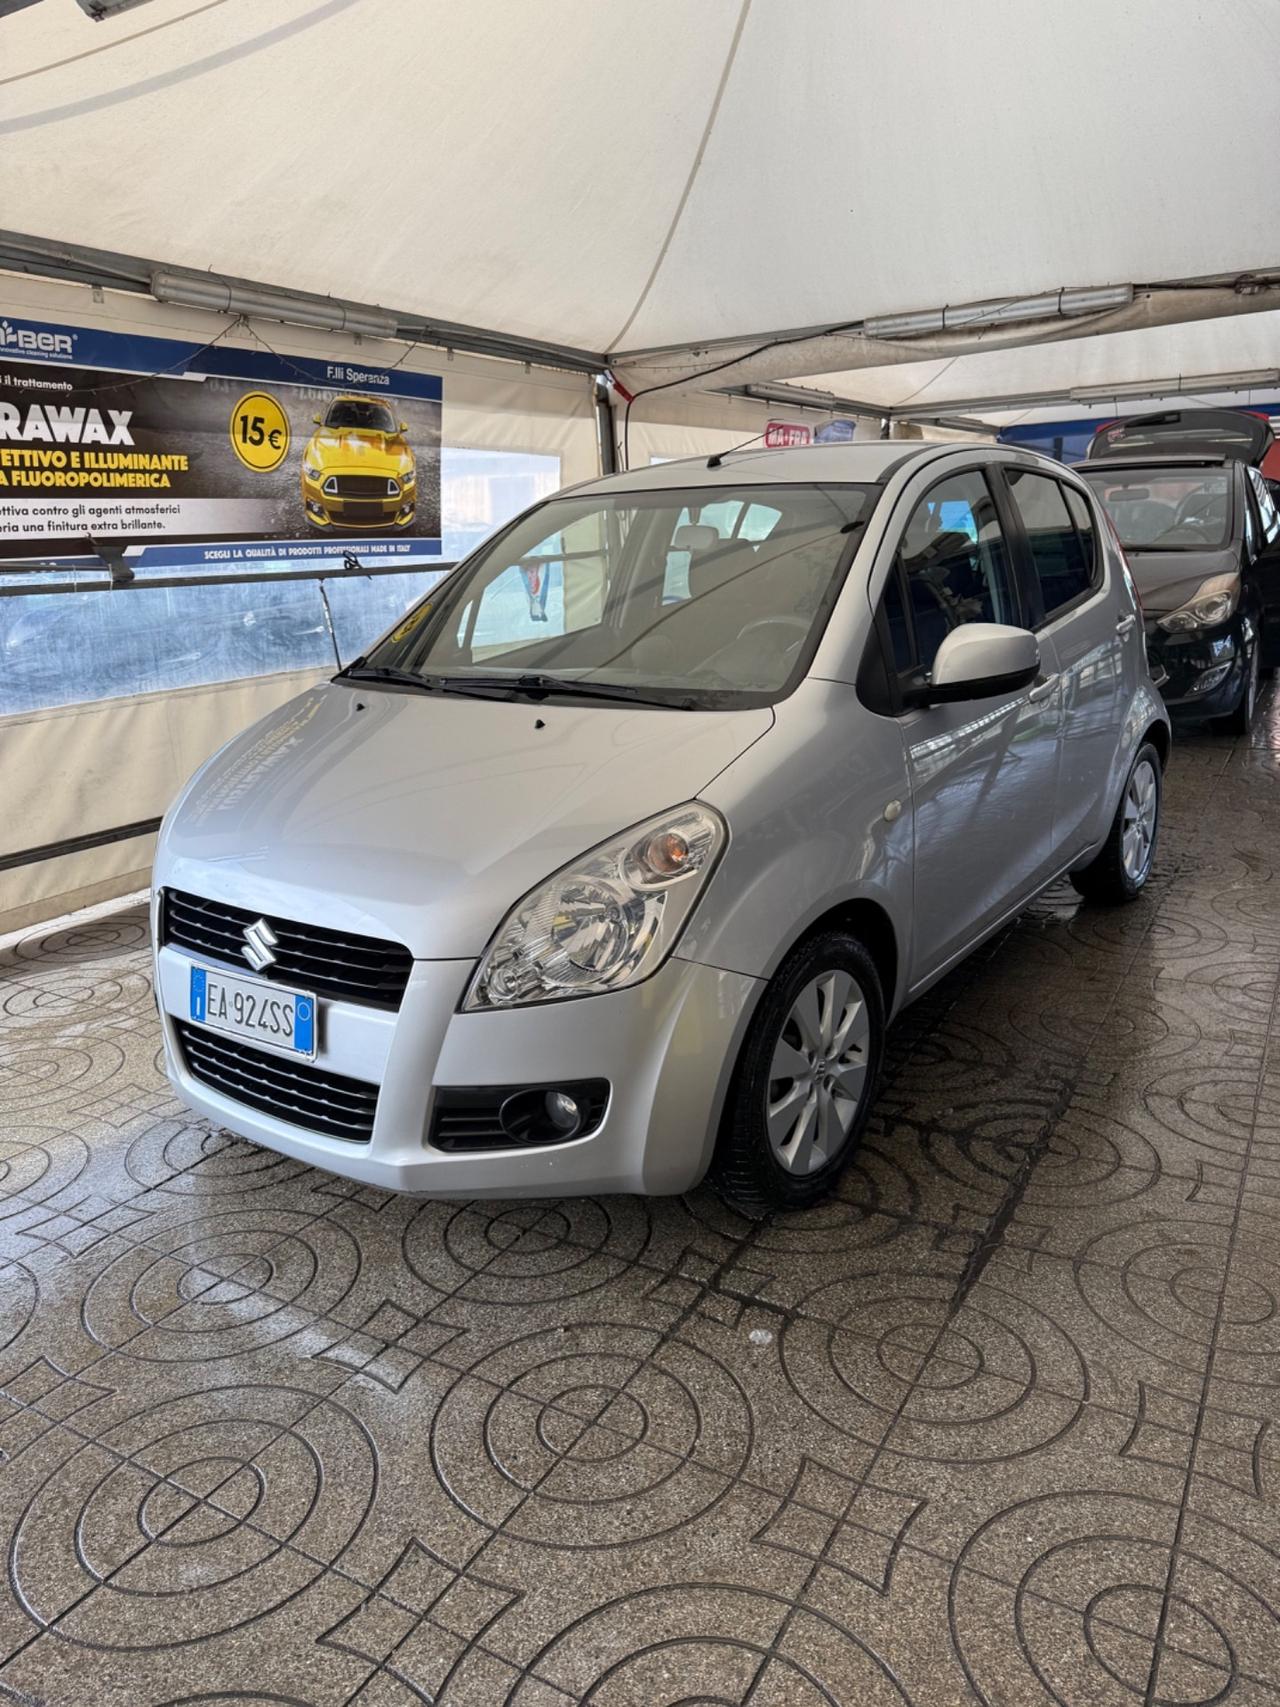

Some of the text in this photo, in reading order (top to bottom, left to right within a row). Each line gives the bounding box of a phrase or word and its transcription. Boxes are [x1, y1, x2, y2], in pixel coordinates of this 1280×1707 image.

[4, 374, 11, 385] il
[13, 377, 73, 391] trattamento
[346, 368, 390, 386] Speranza
[0, 401, 135, 446] RAWAX
[0, 448, 189, 471] ETTIVO E ILLUMINANTE
[11, 471, 171, 488] FLUOROPOLIMERICA
[32, 504, 69, 516] contro
[72, 504, 85, 518] gli
[89, 504, 122, 517] agenti
[125, 504, 181, 515] atmosferici
[23, 523, 44, 532] una
[47, 520, 88, 531] finitura
[91, 520, 118, 530] extra
[121, 519, 166, 530] brillante.
[204, 551, 231, 560] SCEGLI
[233, 550, 243, 558] LA
[245, 545, 276, 558] QUALITÀ
[288, 547, 323, 556] PRODOTTI
[371, 545, 389, 553] MADE
[397, 544, 411, 552] ITALY
[207, 983, 227, 1020] EA
[233, 991, 294, 1037] 924SS
